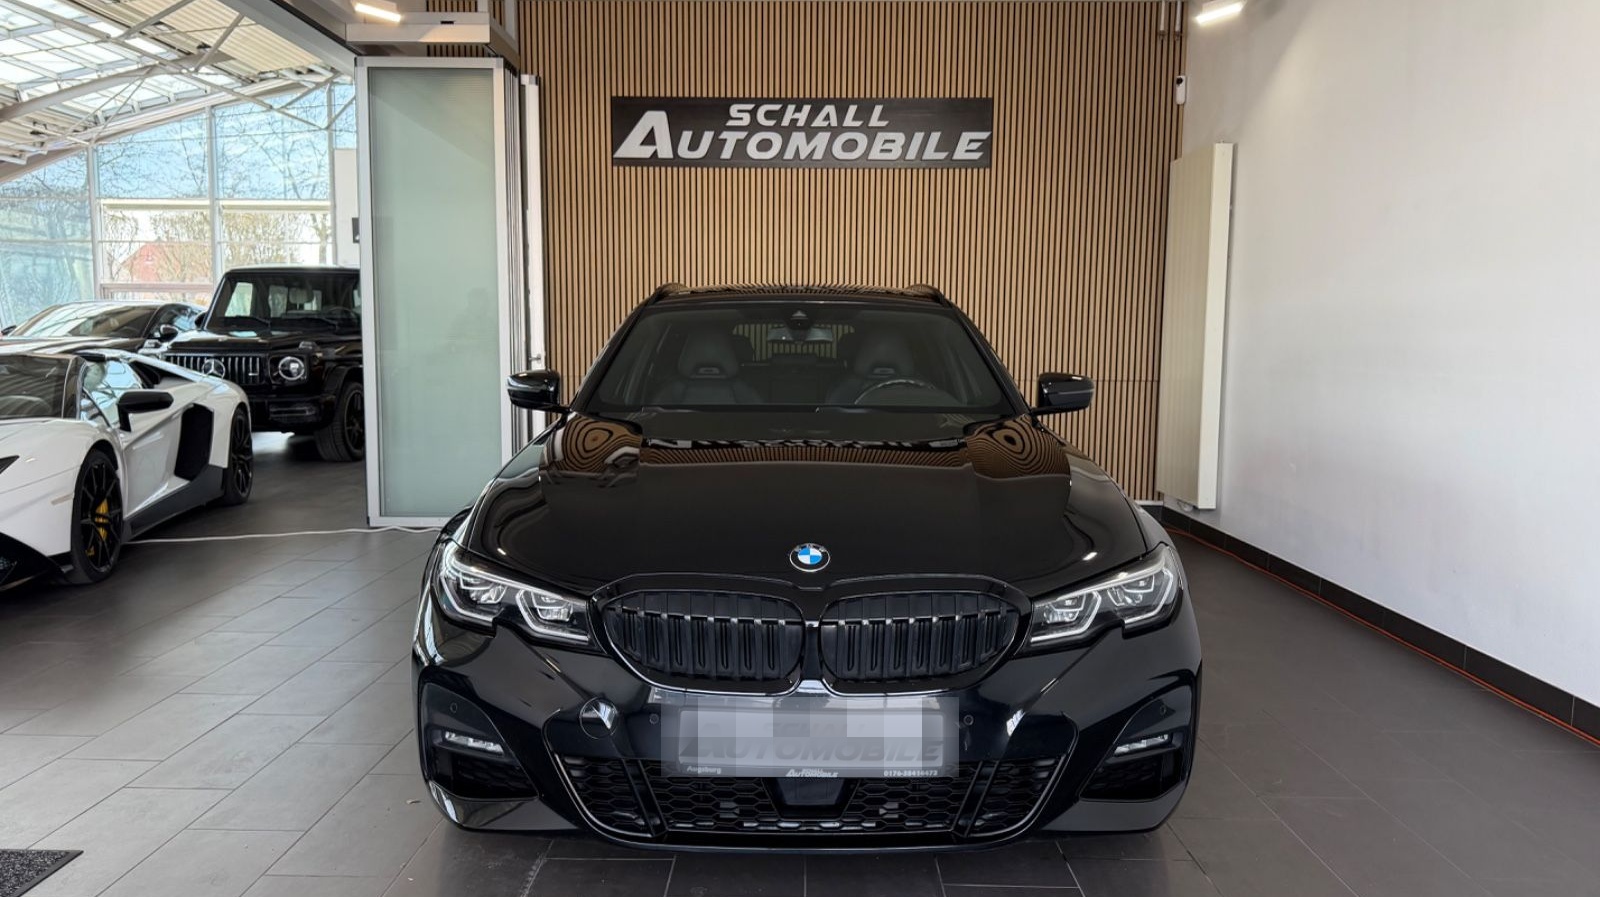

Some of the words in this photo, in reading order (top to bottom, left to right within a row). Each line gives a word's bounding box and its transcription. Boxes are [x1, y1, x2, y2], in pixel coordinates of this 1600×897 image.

[612, 110, 992, 160] AUTOMOBILE
[725, 104, 890, 127] SCHALL
[679, 722, 945, 763] AUTOMOBILE
